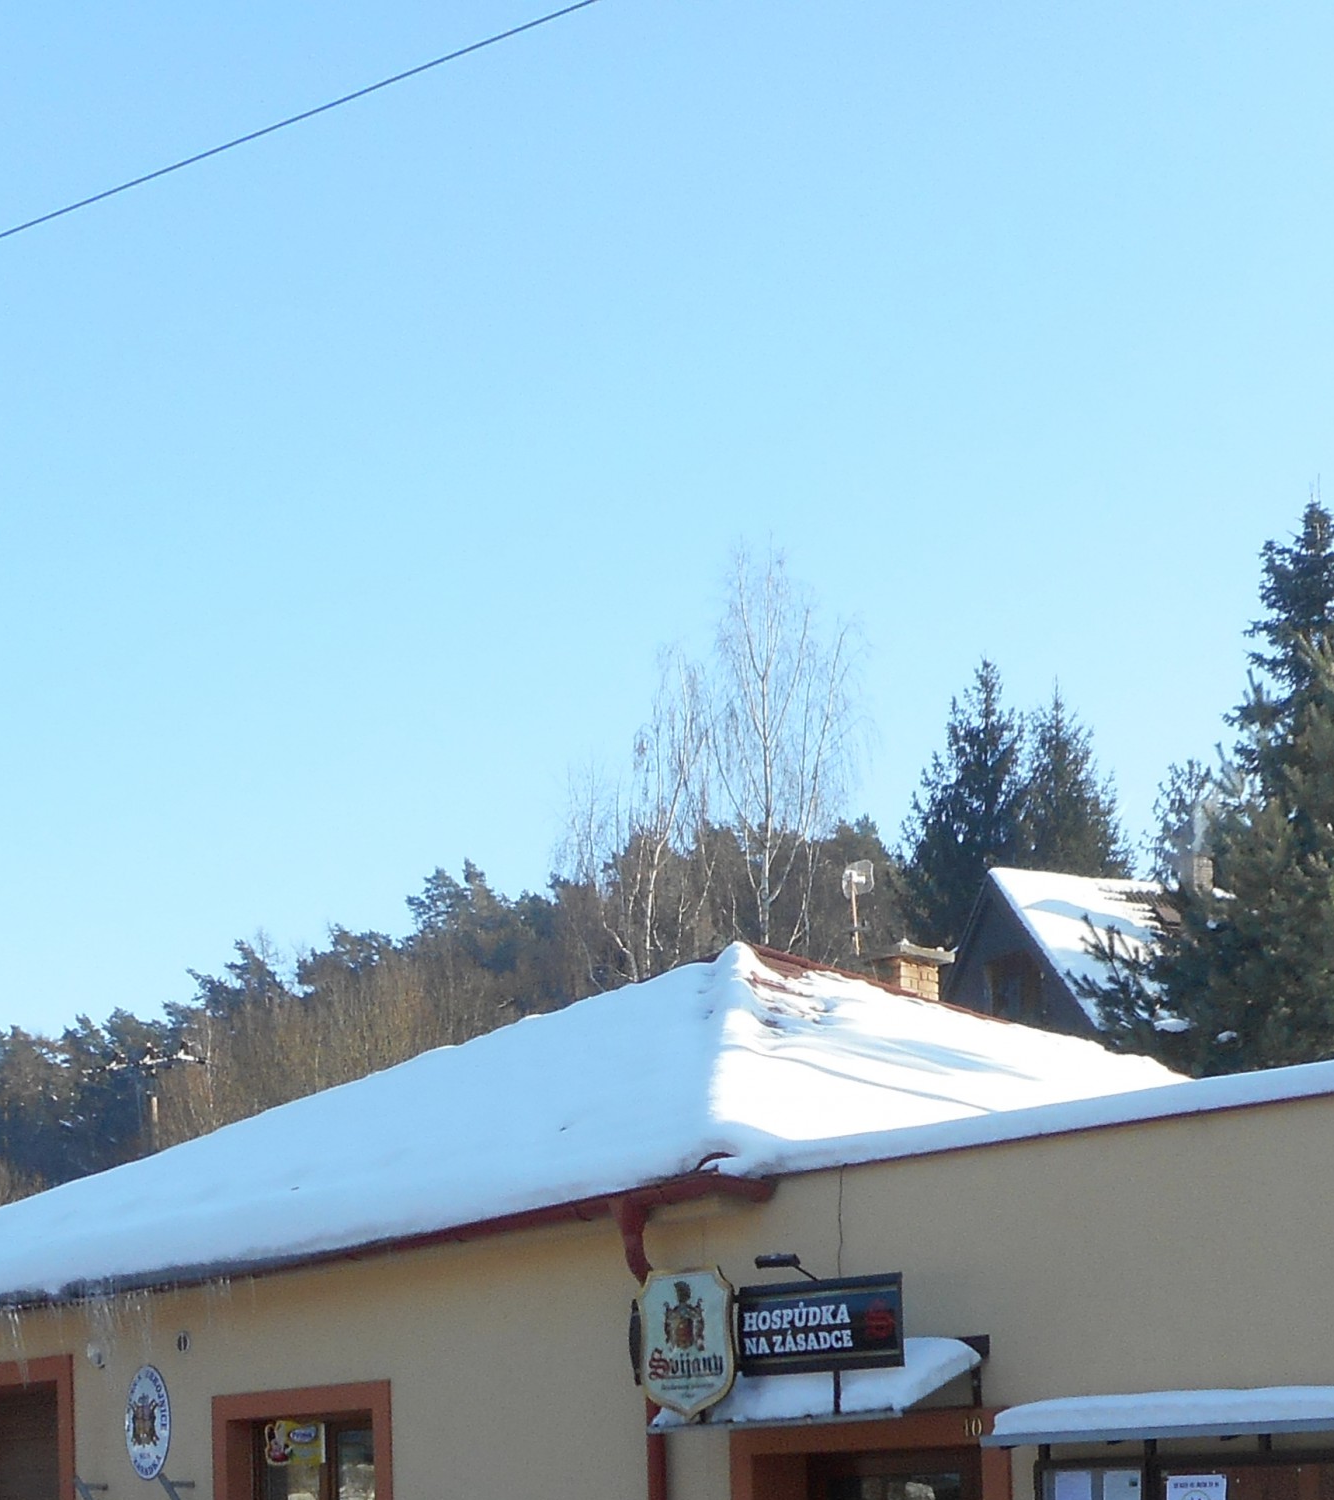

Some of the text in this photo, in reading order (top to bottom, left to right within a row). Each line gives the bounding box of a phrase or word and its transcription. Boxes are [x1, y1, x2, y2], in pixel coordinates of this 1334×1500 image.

[744, 1329, 853, 1355] NA ZÁSADCE
[648, 1347, 724, 1381] Svijany
